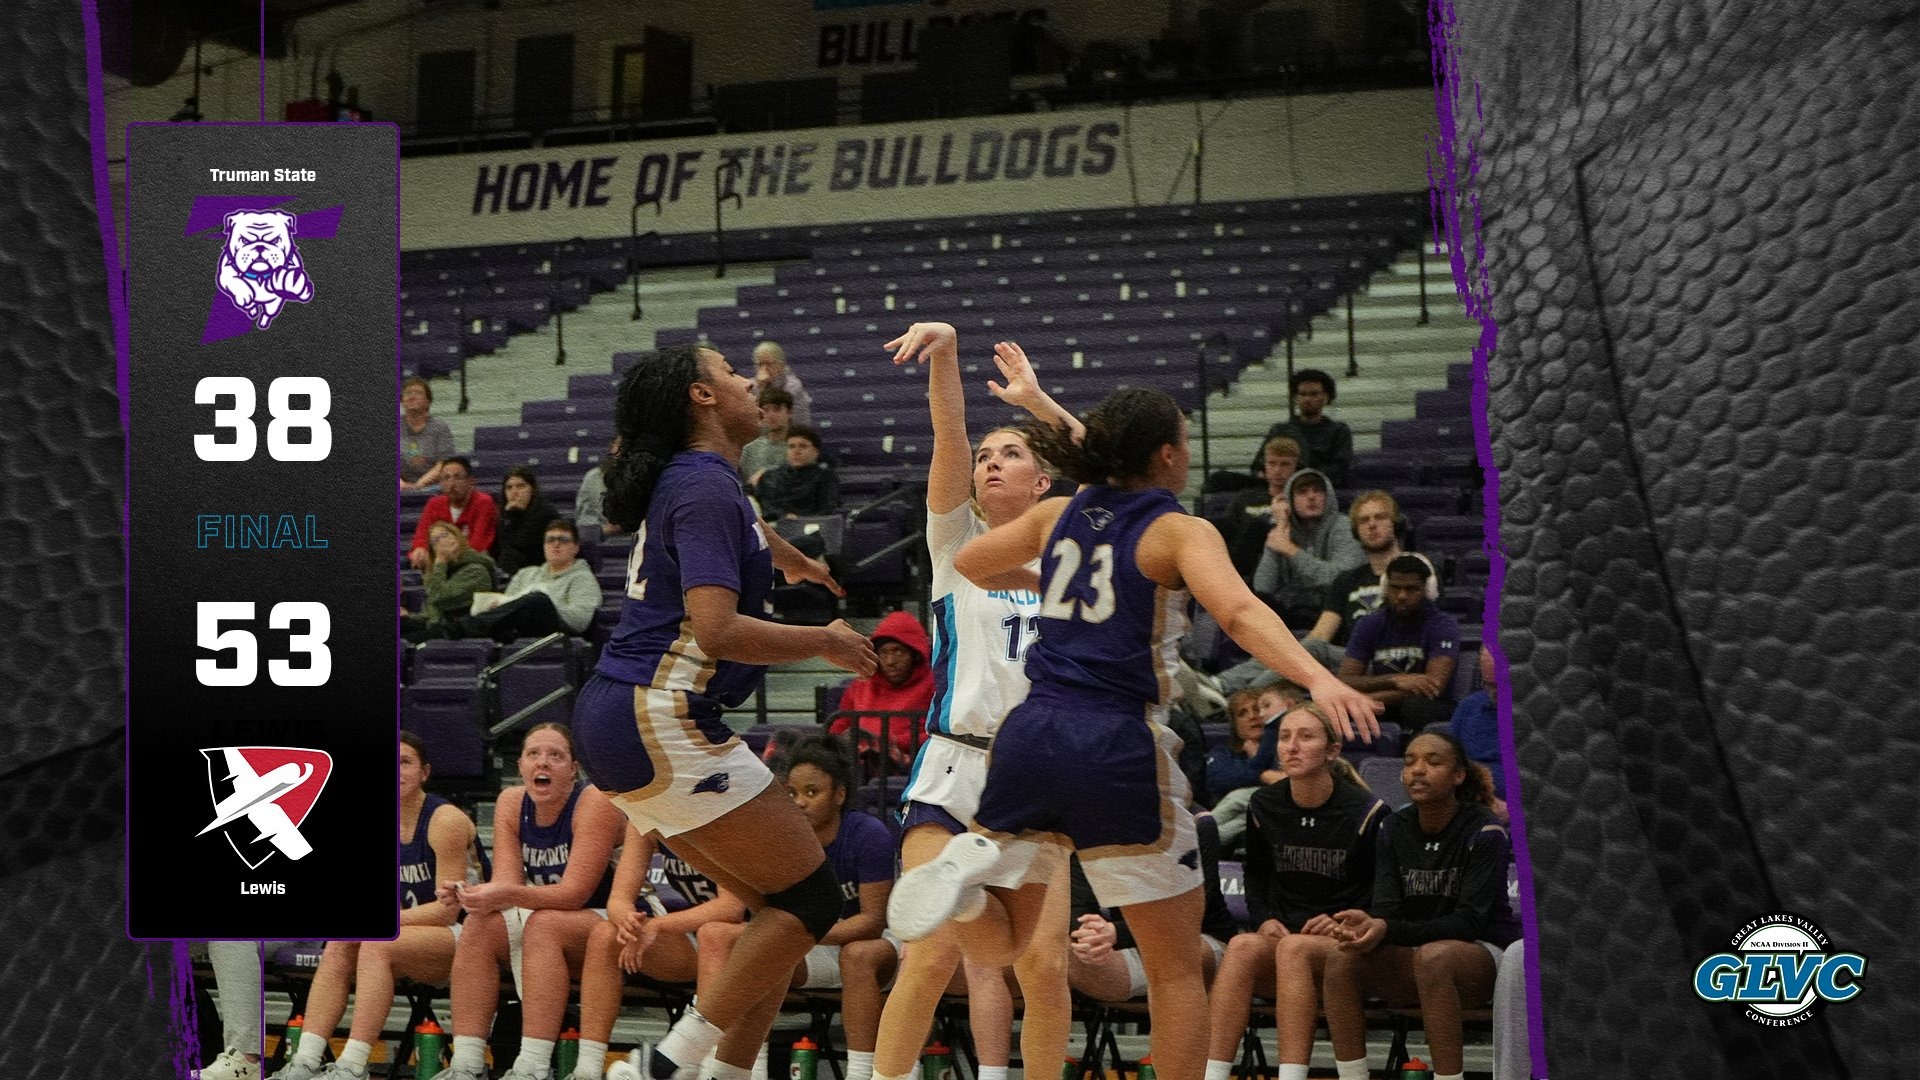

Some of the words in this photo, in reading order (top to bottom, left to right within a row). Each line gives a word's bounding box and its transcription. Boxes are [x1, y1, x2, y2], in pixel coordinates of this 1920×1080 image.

[472, 157, 617, 216] HOME
[634, 150, 704, 202] OF
[717, 142, 816, 199] THE
[829, 122, 1121, 193] BULLDOGS
[1041, 537, 1116, 624] 23
